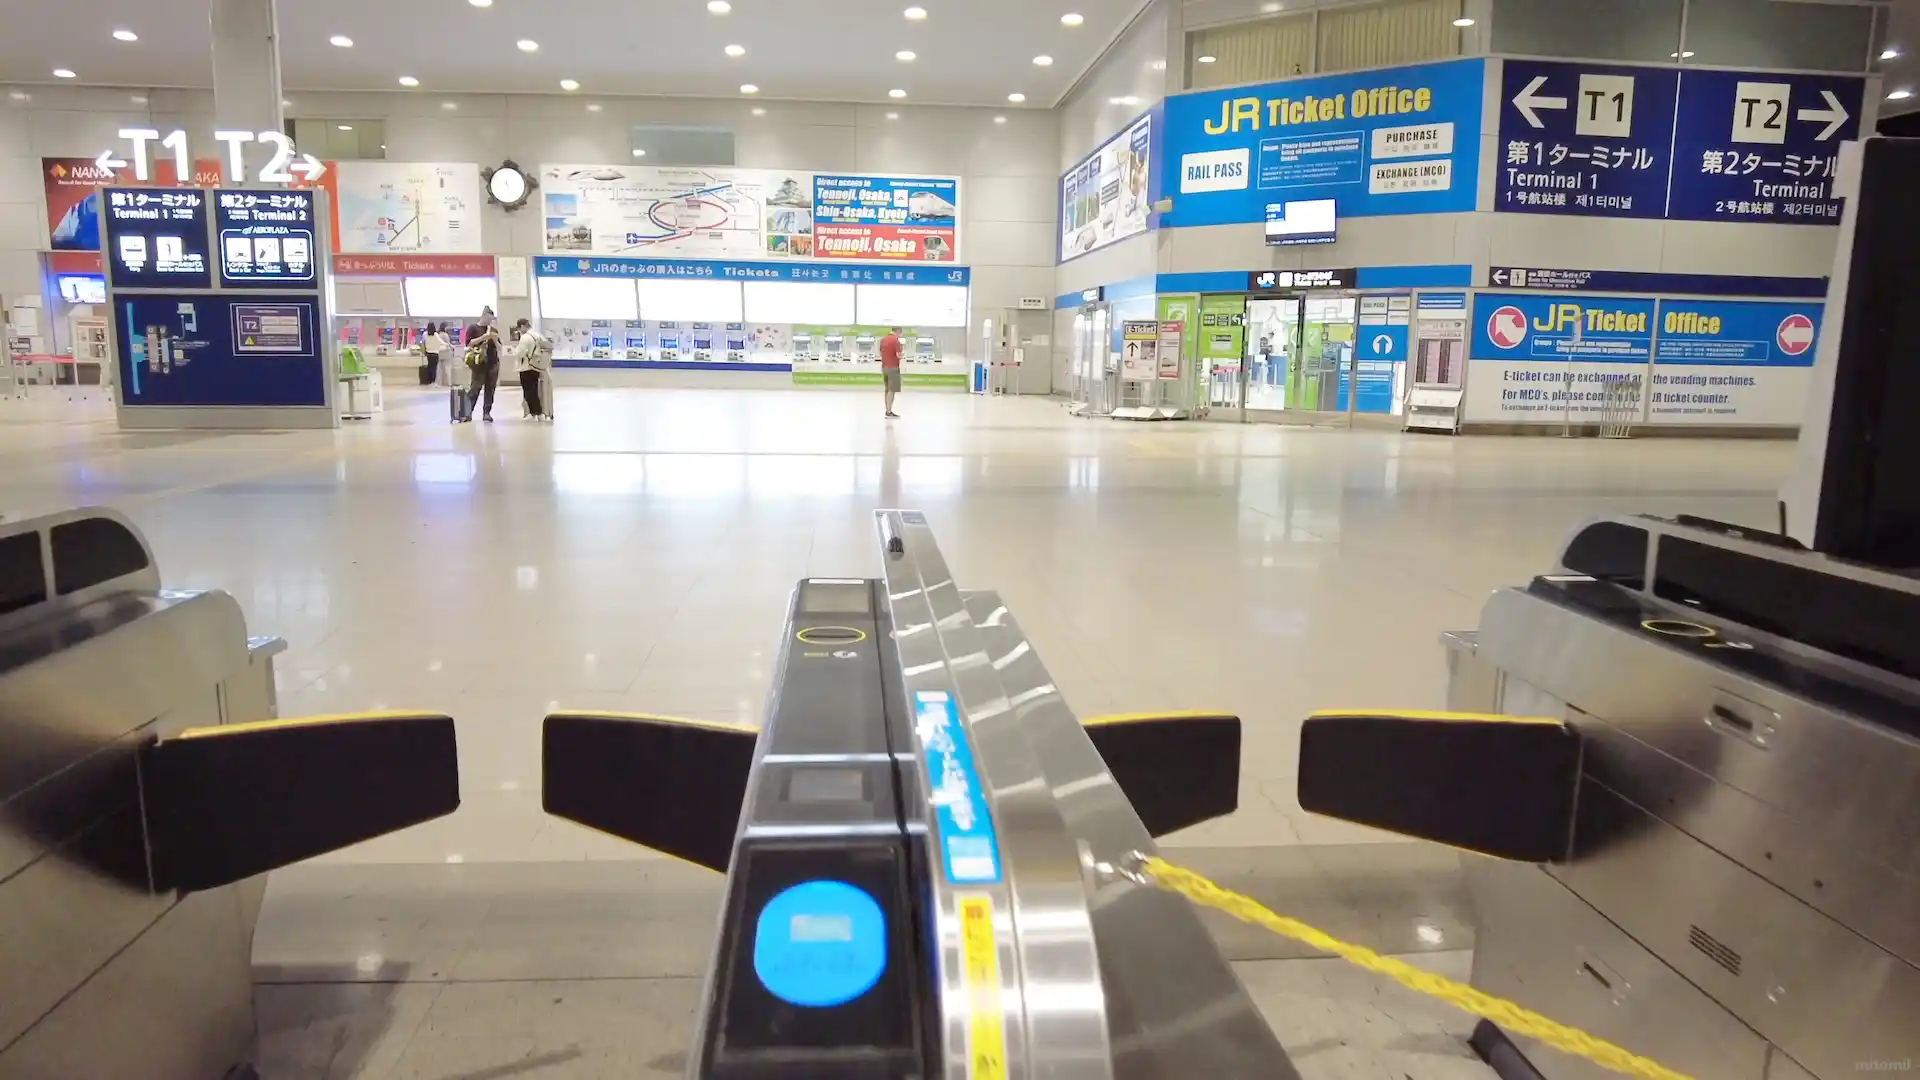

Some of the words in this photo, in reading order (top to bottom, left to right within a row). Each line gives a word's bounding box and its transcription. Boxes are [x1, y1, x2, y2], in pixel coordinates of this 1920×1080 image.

[1204, 97, 1261, 135] JR
[1266, 93, 1345, 127] Ticket
[1351, 87, 1432, 118] Office
[1584, 91, 1624, 122] T1
[1741, 98, 1783, 129] T2
[1386, 130, 1438, 143] PURCHASE
[118, 129, 189, 181] T1
[215, 131, 296, 183] T2
[1507, 140, 1654, 170] 第1ターミナル
[1188, 165, 1211, 181] RAIL
[1214, 162, 1243, 178] PASS
[1377, 167, 1418, 179] EXCHANGE
[1507, 168, 1582, 189] Terminal
[1590, 174, 1597, 189] 1
[859, 189, 893, 203] Osaka,
[1753, 179, 1824, 199] Terminal
[111, 192, 200, 207] 第1ターミナル
[221, 194, 307, 208] 第2ターミナル
[113, 208, 158, 219] Terminal
[163, 209, 168, 219] 1
[252, 210, 296, 220] Terminal
[299, 211, 306, 220] 2
[873, 237, 917, 253] Osaka
[723, 267, 779, 277] Tickets
[1586, 309, 1648, 332] Ticket
[1664, 312, 1721, 334] Office
[1504, 370, 1541, 382] E-ticket
[1543, 373, 1561, 382] can
[1653, 374, 1668, 384] the
[1670, 374, 1707, 386] vending
[1502, 389, 1517, 400] For
[1652, 392, 1662, 402] JR
[1663, 392, 1690, 403] ticket
